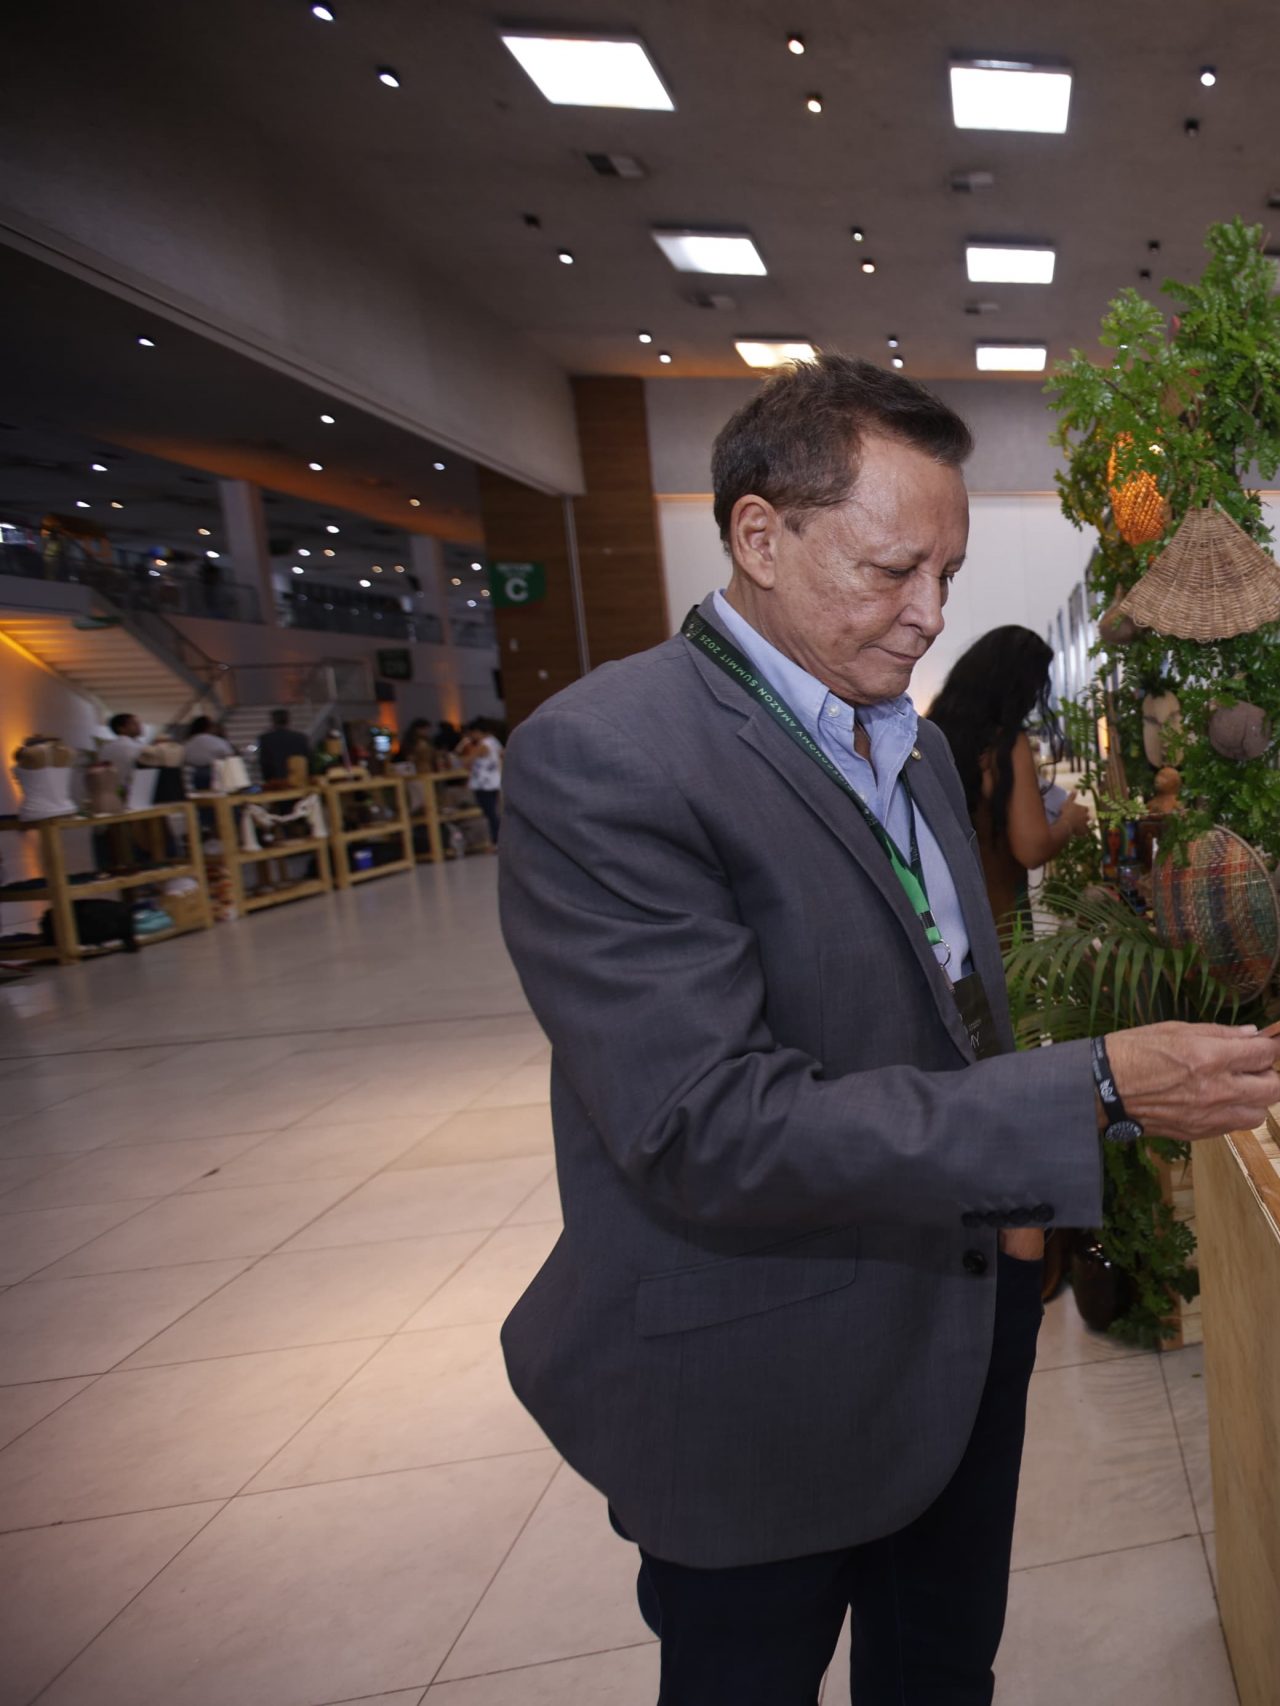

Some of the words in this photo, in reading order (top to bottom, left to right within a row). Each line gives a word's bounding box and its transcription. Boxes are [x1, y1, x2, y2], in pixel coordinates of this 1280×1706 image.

[506, 578, 528, 601] C
[700, 634, 721, 653] 2025
[720, 654, 759, 687] SUMMIT
[757, 688, 797, 727] AMAZON
